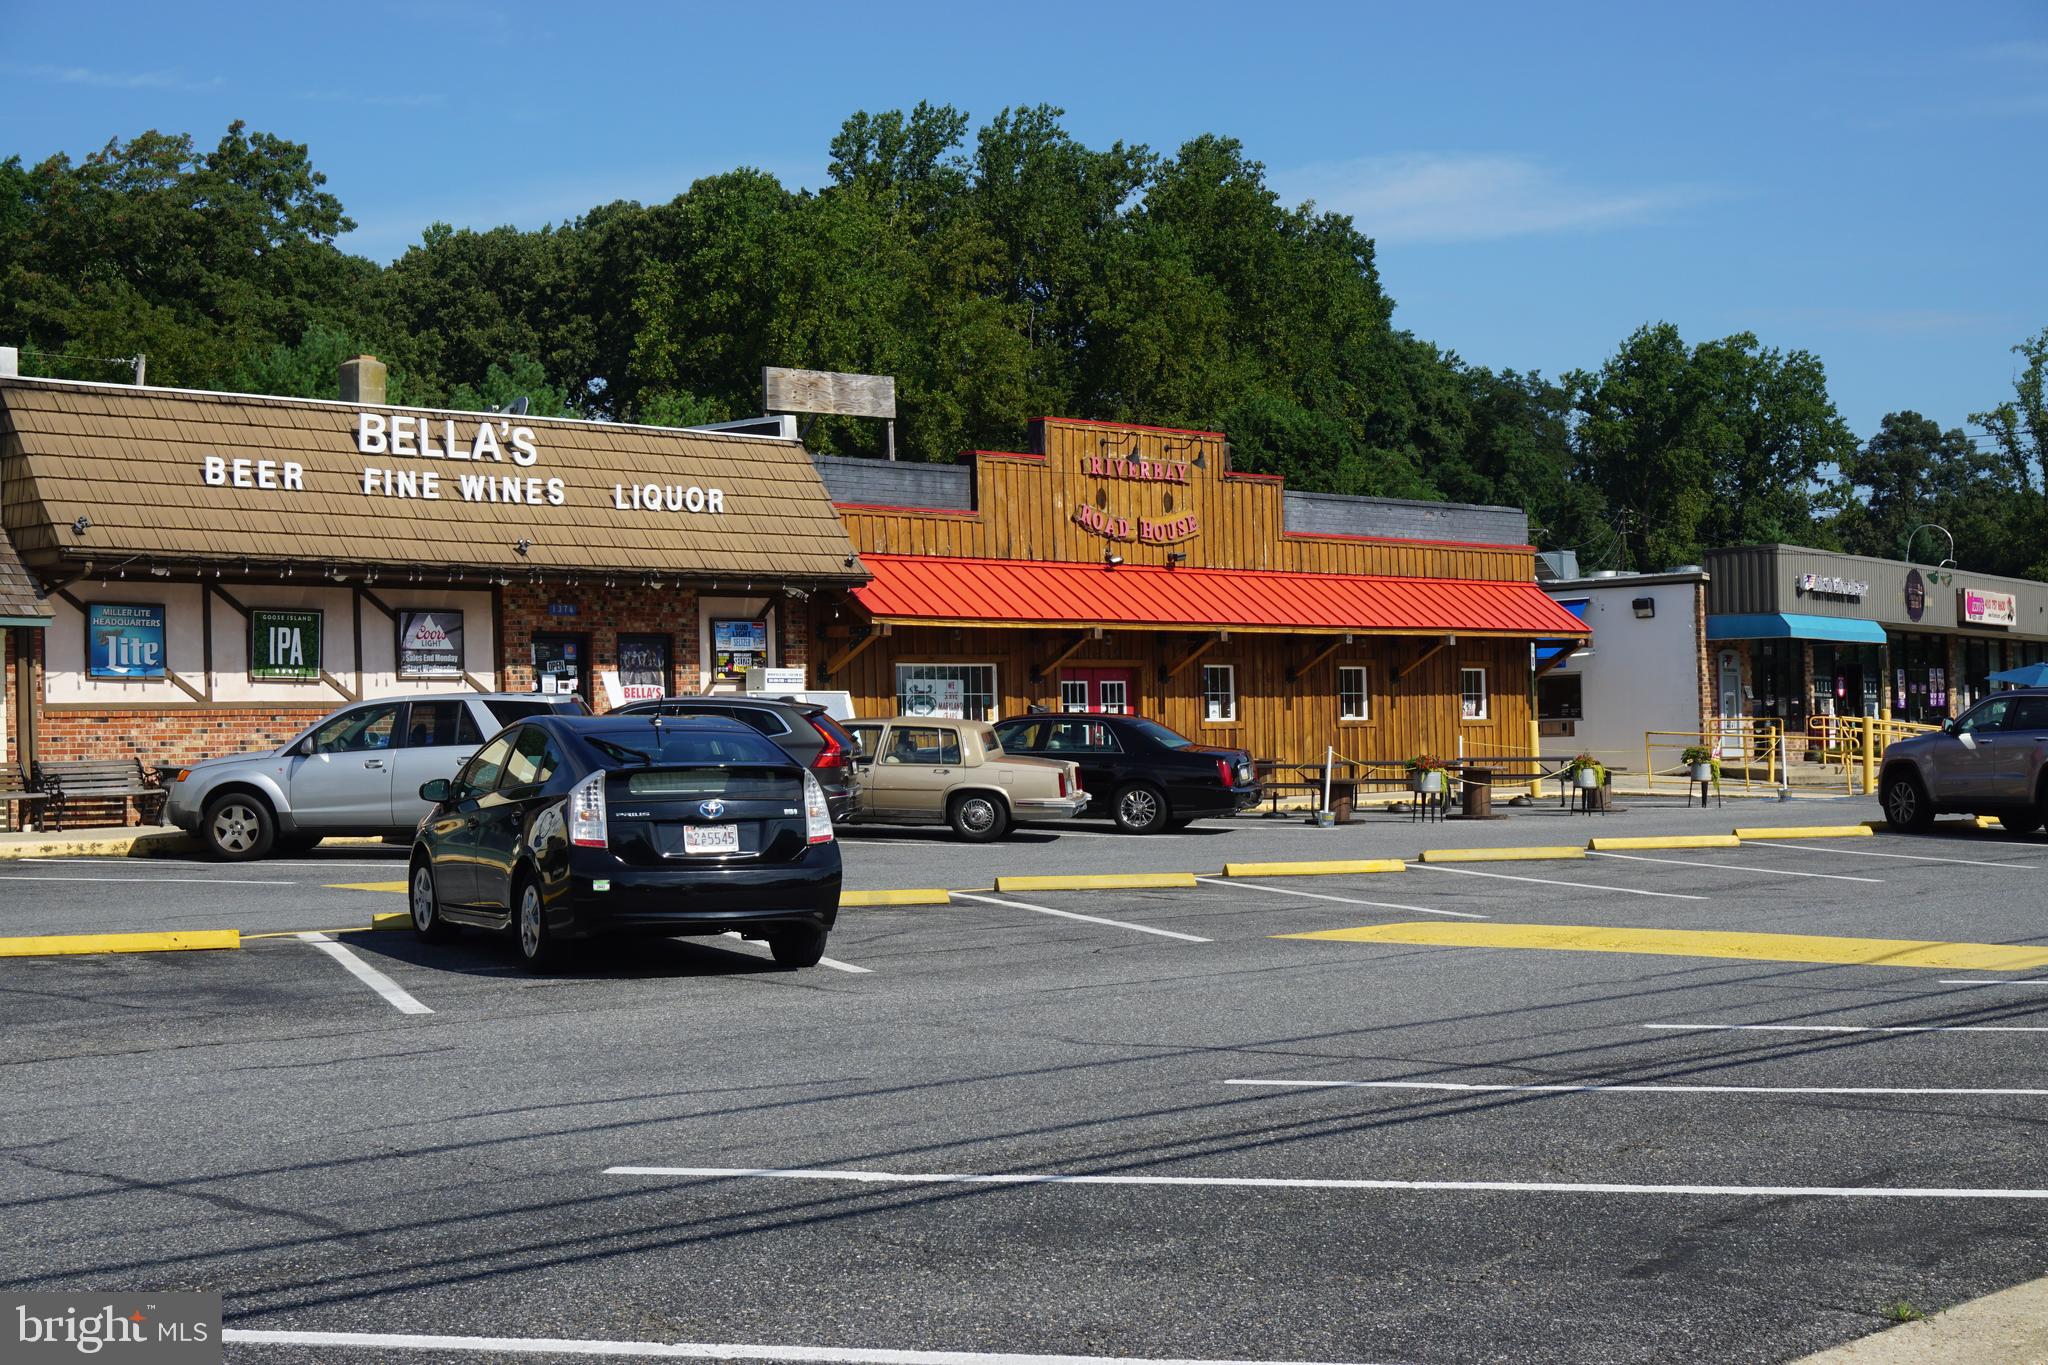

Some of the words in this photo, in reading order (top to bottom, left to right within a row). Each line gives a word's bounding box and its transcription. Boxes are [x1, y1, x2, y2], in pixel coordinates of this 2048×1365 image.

[358, 412, 538, 467] BELLA'S
[1090, 456, 1188, 481] RIVERBAY
[205, 456, 303, 490] BEER
[364, 467, 440, 499] FINE
[460, 474, 565, 506] WINES
[615, 483, 724, 513] LIQUOR
[1080, 504, 1130, 537] ROAD
[1140, 514, 1199, 542] HOUSE
[92, 617, 161, 627] HEADQUARTERS
[102, 608, 133, 616] MILLER
[134, 609, 151, 617] LITE
[416, 624, 447, 640] Coors
[106, 635, 160, 671] Lite
[269, 627, 303, 665] IPA
[405, 654, 423, 662] Sales
[424, 654, 435, 662] End
[435, 654, 458, 663] Monday
[623, 687, 662, 699] BELLA'S
